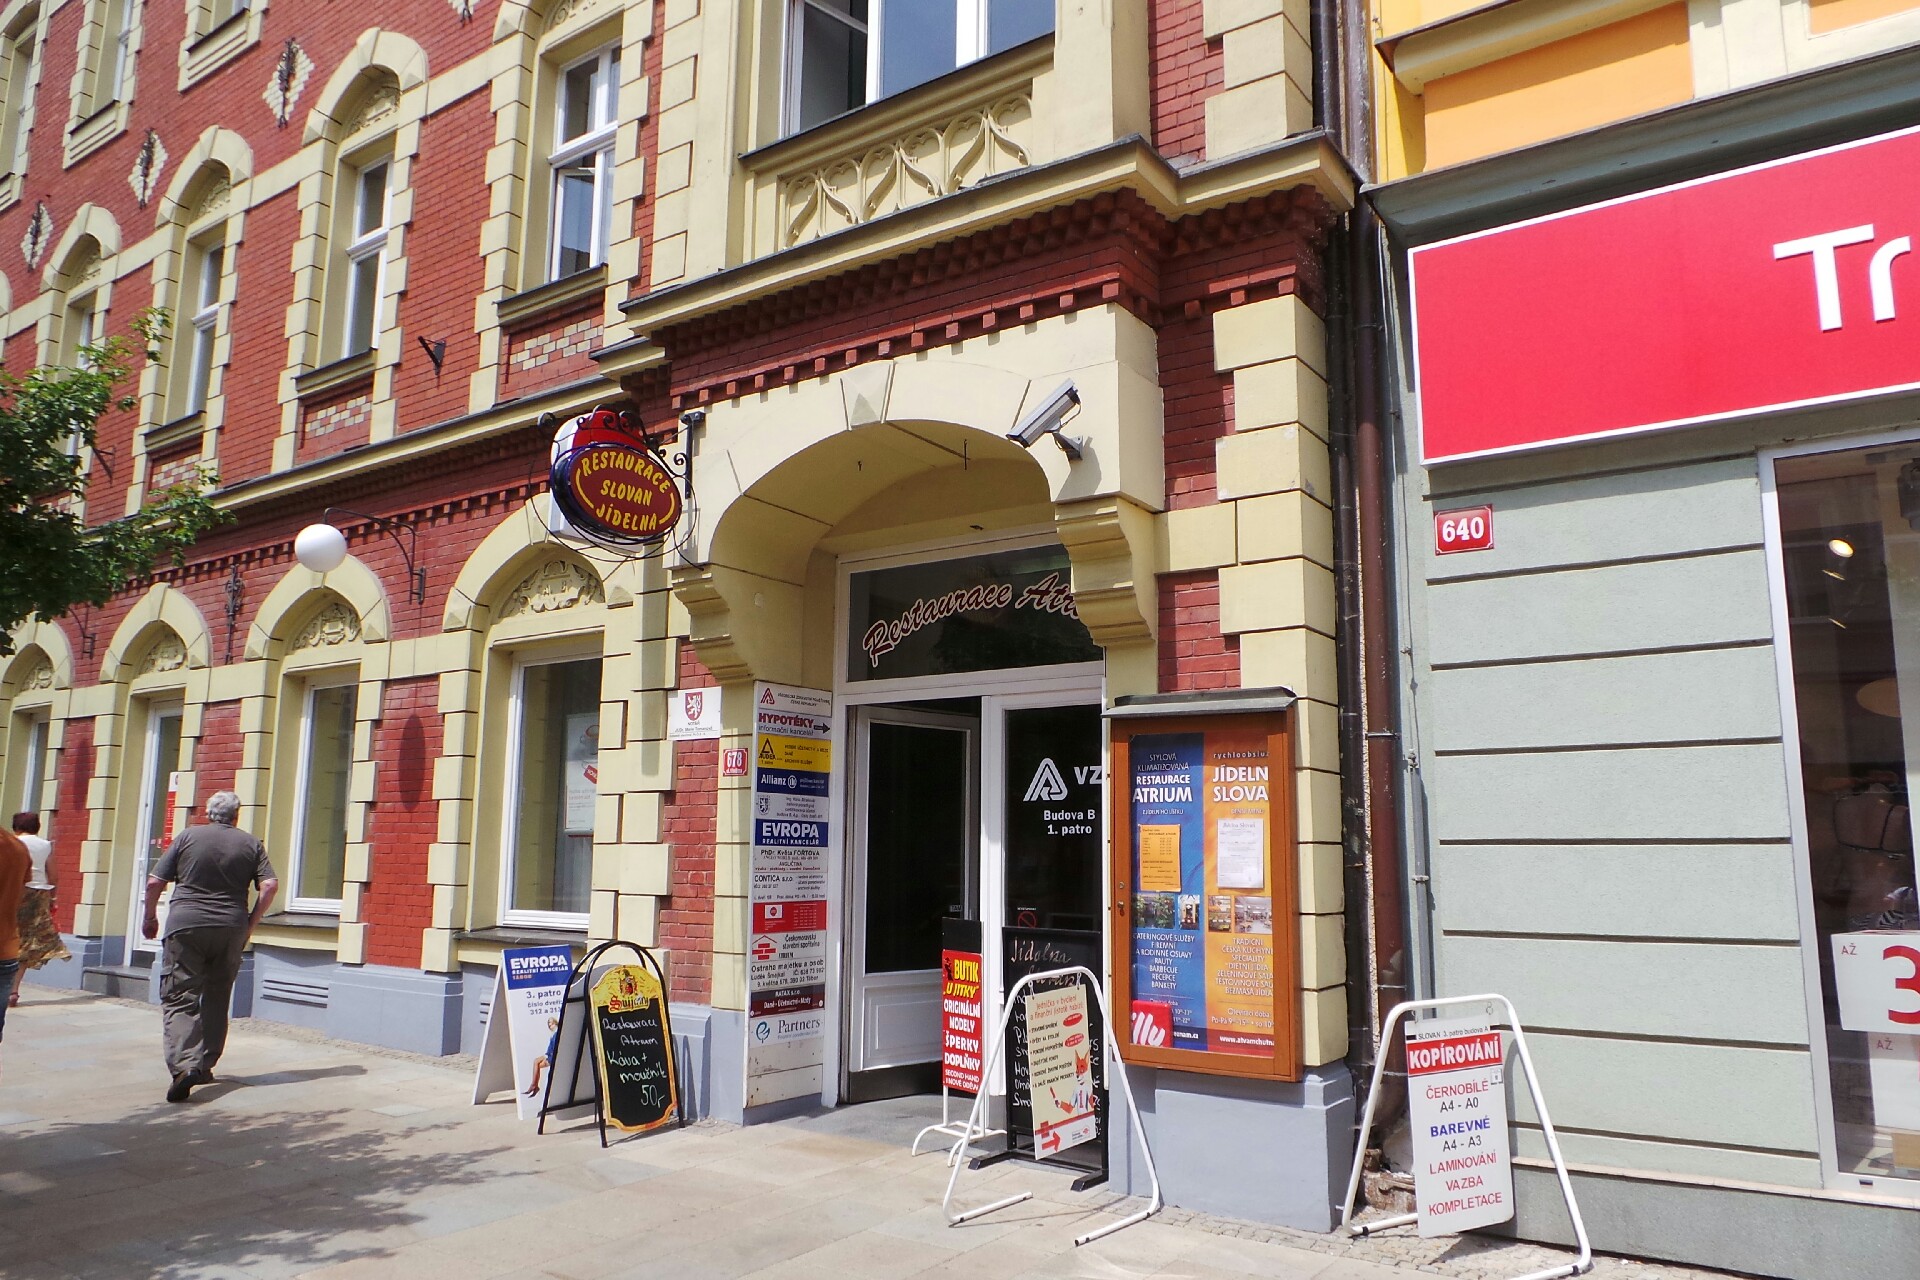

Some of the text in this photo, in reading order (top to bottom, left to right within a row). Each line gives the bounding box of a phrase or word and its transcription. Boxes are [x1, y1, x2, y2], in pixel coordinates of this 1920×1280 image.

[1772, 223, 1911, 332] Tr
[582, 451, 671, 493] RESTAURACE
[600, 479, 653, 507] SLOVAN
[596, 503, 657, 531] JÍDELNA
[1442, 516, 1485, 543] 640
[863, 584, 1012, 667] Restaurace
[759, 713, 814, 728] HYPOTÉKY
[759, 725, 789, 734] informační
[727, 752, 743, 768] 678
[1149, 752, 1177, 761] STYLOVÁ
[1137, 762, 1189, 772] KLIMATIZOVANÁ
[1212, 764, 1269, 782] JÍDELN
[761, 774, 787, 786] Allianz
[1136, 774, 1191, 785] RESTAURACE
[1132, 786, 1193, 803] ATRIUM
[1213, 785, 1269, 802] SLOVA
[1043, 808, 1096, 821] Budova B
[762, 822, 819, 838] EVROPA
[1047, 823, 1092, 837] 1. patro
[754, 874, 781, 883] CONTICA
[1174, 934, 1195, 942] SLUŽBY
[1141, 949, 1168, 957] RODINNÉ
[1169, 950, 1192, 959] OSLAVY
[1841, 942, 1857, 956] AŽ
[510, 954, 568, 970] EVROPA
[751, 964, 776, 972] Ostraha
[777, 961, 802, 970] majetku
[809, 958, 824, 967] osob
[1232, 954, 1265, 963] SPECIALITY
[954, 959, 979, 983] BUTIK
[1149, 965, 1178, 974] BARBECUE
[1152, 973, 1176, 982] RECEPCE
[1151, 981, 1177, 990] BANKETY
[526, 989, 561, 999] 3. patro
[944, 999, 981, 1019] ORIGINÁLNÍ
[1255, 1010, 1270, 1018] doba
[778, 1019, 820, 1034] Partners
[949, 1015, 975, 1034] MODELY
[1418, 1031, 1441, 1040] SLOVAN
[1449, 1029, 1463, 1037] patro
[1464, 1026, 1484, 1035] budova
[945, 1030, 979, 1053] ŠPERKY
[1876, 1037, 1895, 1051] AŽ
[606, 1050, 641, 1067] Káva
[1409, 1036, 1499, 1069] KOPÍROVÁNÍ
[944, 1051, 981, 1072] DOPLŇKY
[945, 1068, 979, 1083] SECOND HAND
[948, 1077, 962, 1087] NOVÉ
[1426, 1078, 1489, 1100] ČERNOBÍLÉ
[1440, 1097, 1479, 1113] A4 A0
[1430, 1115, 1491, 1137] BAREVNÉ
[1443, 1135, 1482, 1152] A4 A3
[1429, 1149, 1497, 1175] LAMINOVÁNÍ
[1445, 1175, 1484, 1192] VAZBA
[1428, 1192, 1502, 1216] KOMPLETACE
